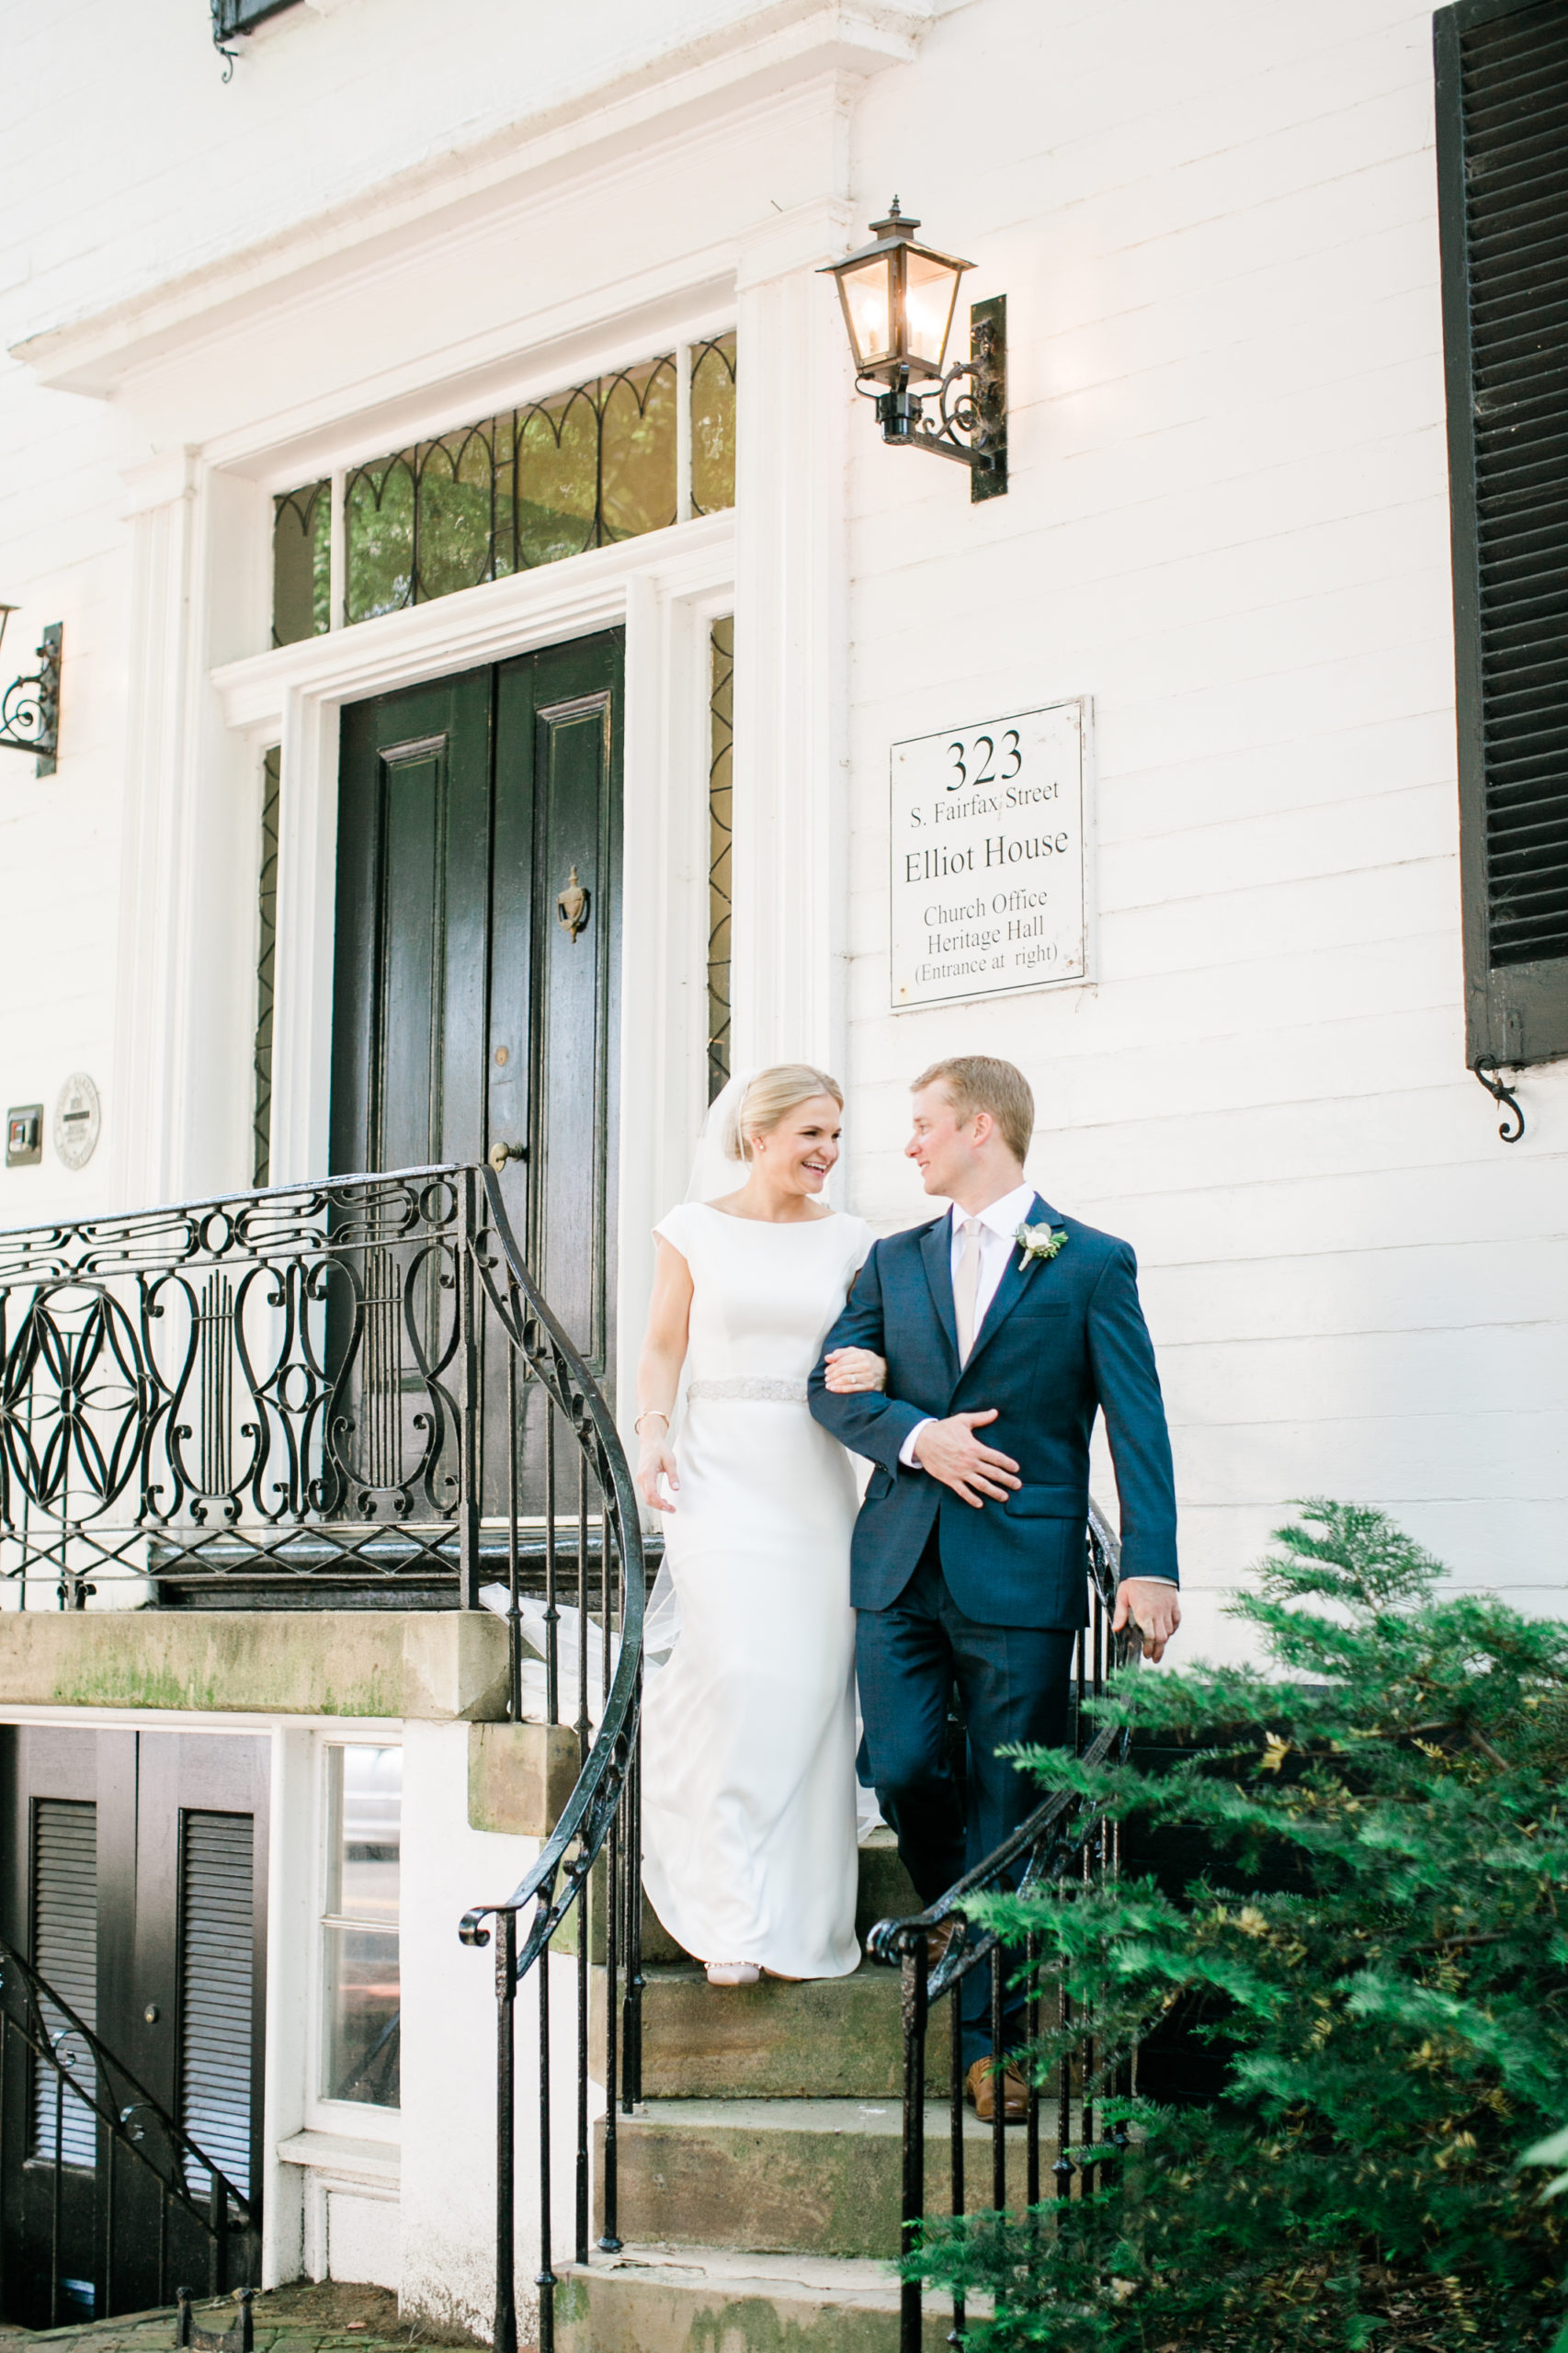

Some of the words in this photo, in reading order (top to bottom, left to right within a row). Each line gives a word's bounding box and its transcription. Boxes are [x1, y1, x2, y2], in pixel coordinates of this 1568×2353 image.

[946, 729, 1022, 791] 323
[911, 807, 926, 828] S.
[935, 795, 998, 824] Fairfax
[1006, 781, 1059, 809] Street
[904, 846, 974, 883] Elliot
[985, 831, 1069, 867] House
[925, 899, 985, 926] Church
[992, 890, 1048, 914] Office
[927, 927, 1000, 954] Heritage
[1007, 915, 1044, 940] Hall
[915, 961, 986, 985] (Entrance
[992, 954, 1005, 969] at
[1015, 943, 1058, 968] right)
